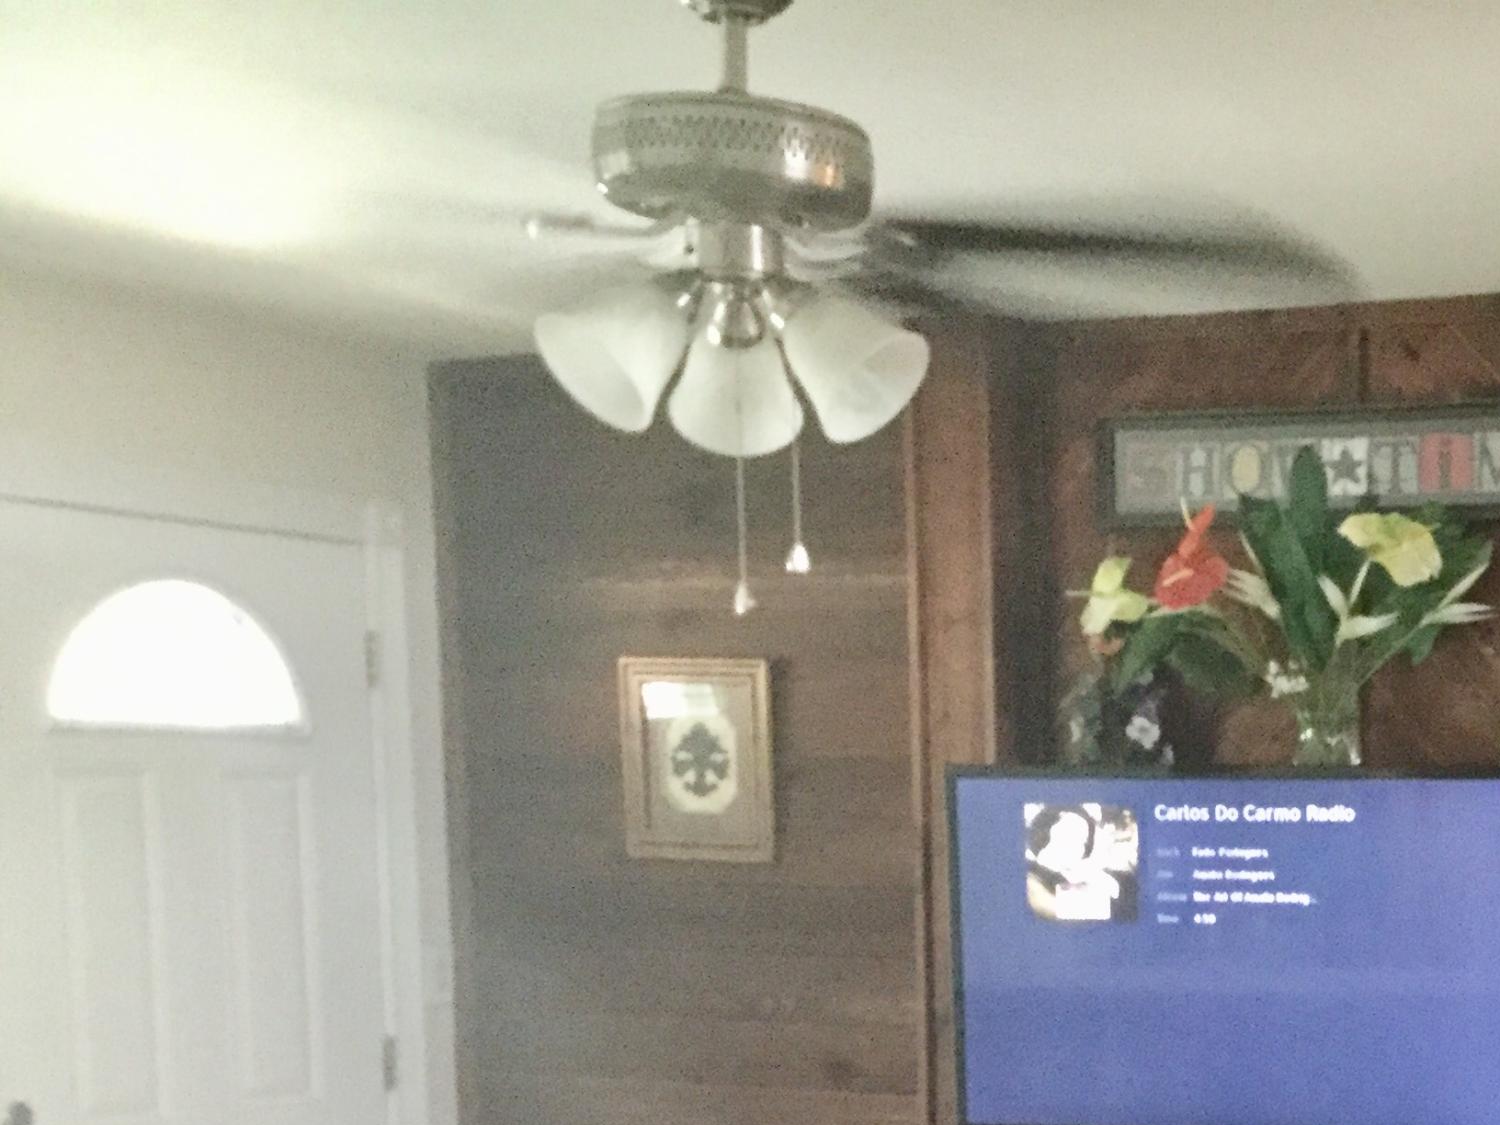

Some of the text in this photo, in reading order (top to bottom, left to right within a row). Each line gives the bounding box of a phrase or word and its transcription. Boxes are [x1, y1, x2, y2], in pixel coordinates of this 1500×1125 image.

[1154, 804, 1356, 822] Carlos Do Carmo Radio
